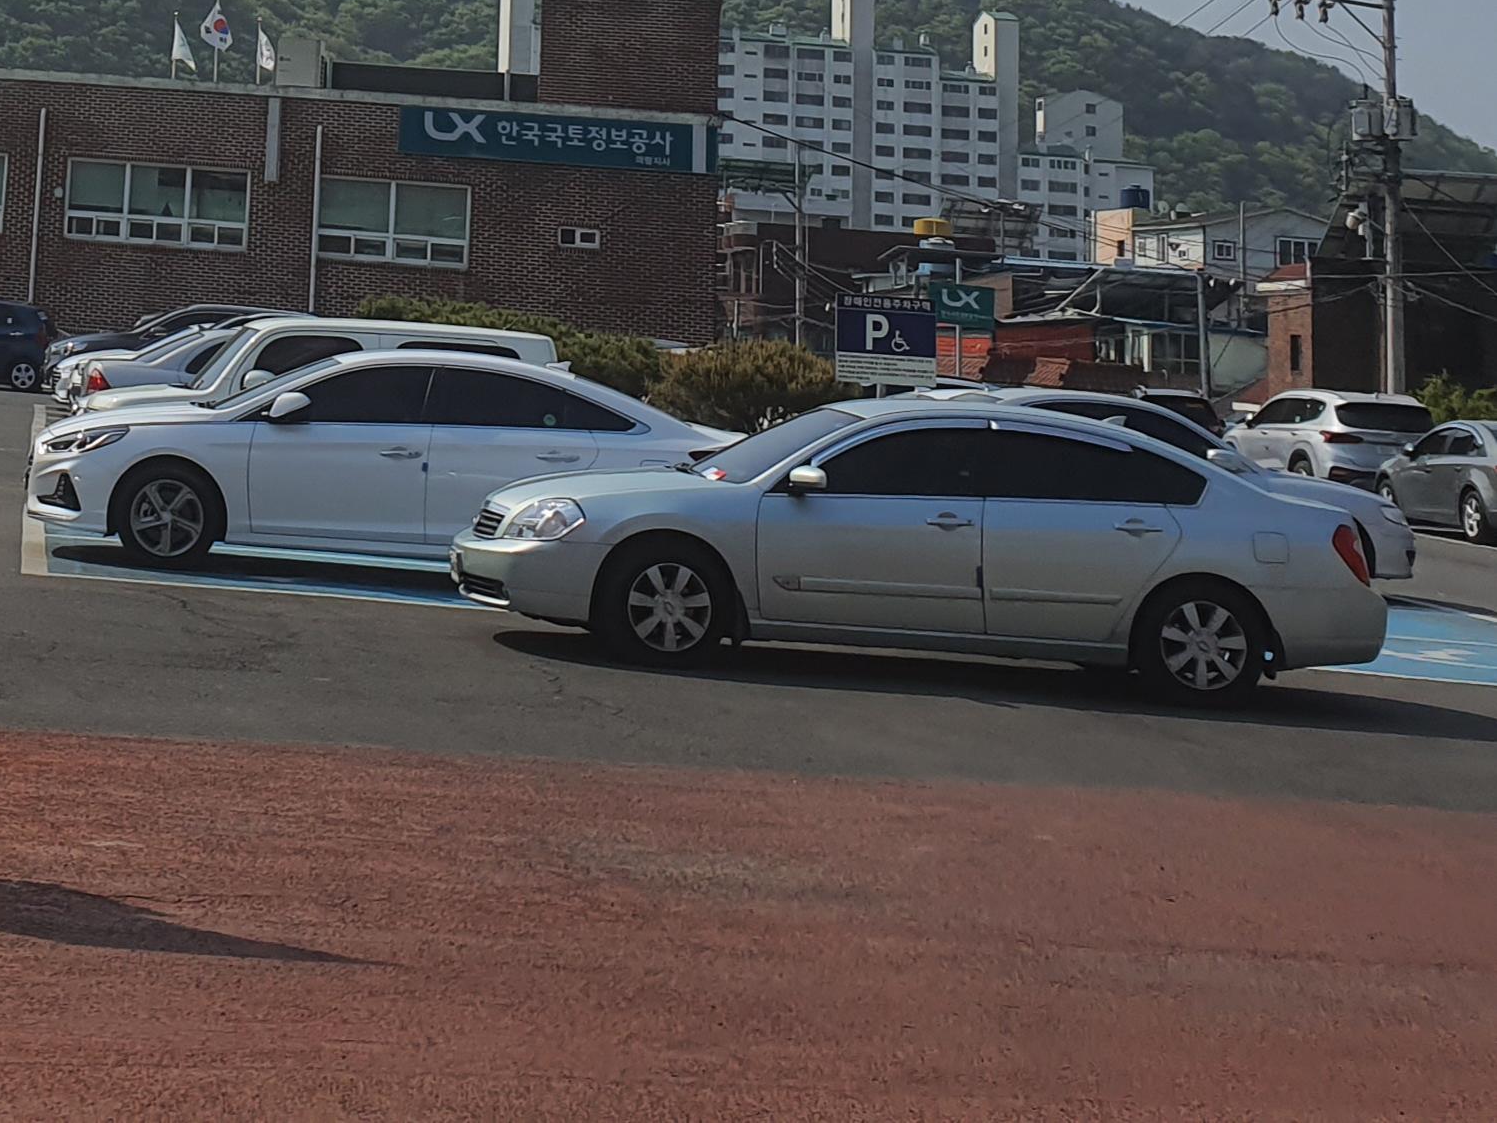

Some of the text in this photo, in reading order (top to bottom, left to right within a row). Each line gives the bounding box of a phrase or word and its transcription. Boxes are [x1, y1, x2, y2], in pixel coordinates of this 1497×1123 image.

[423, 110, 674, 156] LX 한국국토정보공사
[941, 288, 980, 310] LX
[865, 313, 890, 351] P
